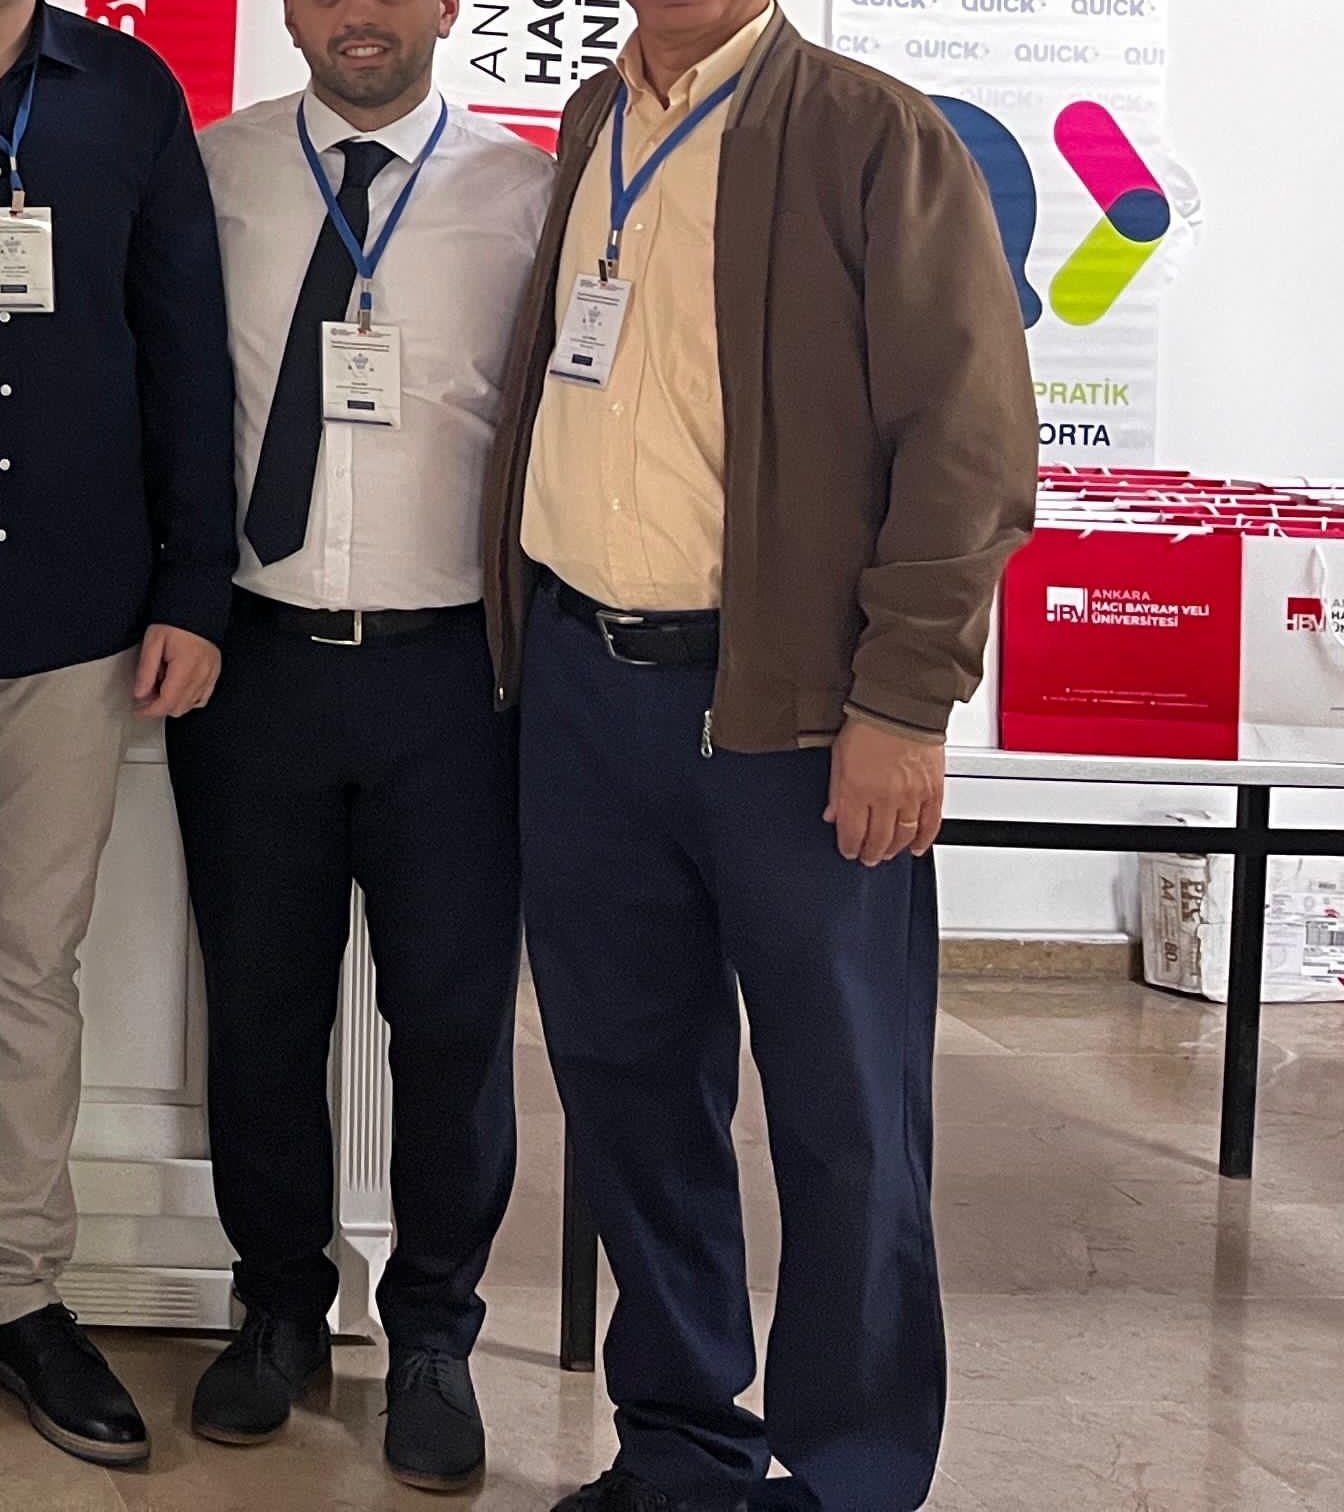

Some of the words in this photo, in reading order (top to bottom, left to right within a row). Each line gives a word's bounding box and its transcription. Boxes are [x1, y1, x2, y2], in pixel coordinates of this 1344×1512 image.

[1033, 377, 1129, 405] PRATİK
[1091, 589, 1151, 601] ANKARA
[1125, 603, 1178, 615] BAYRAM
